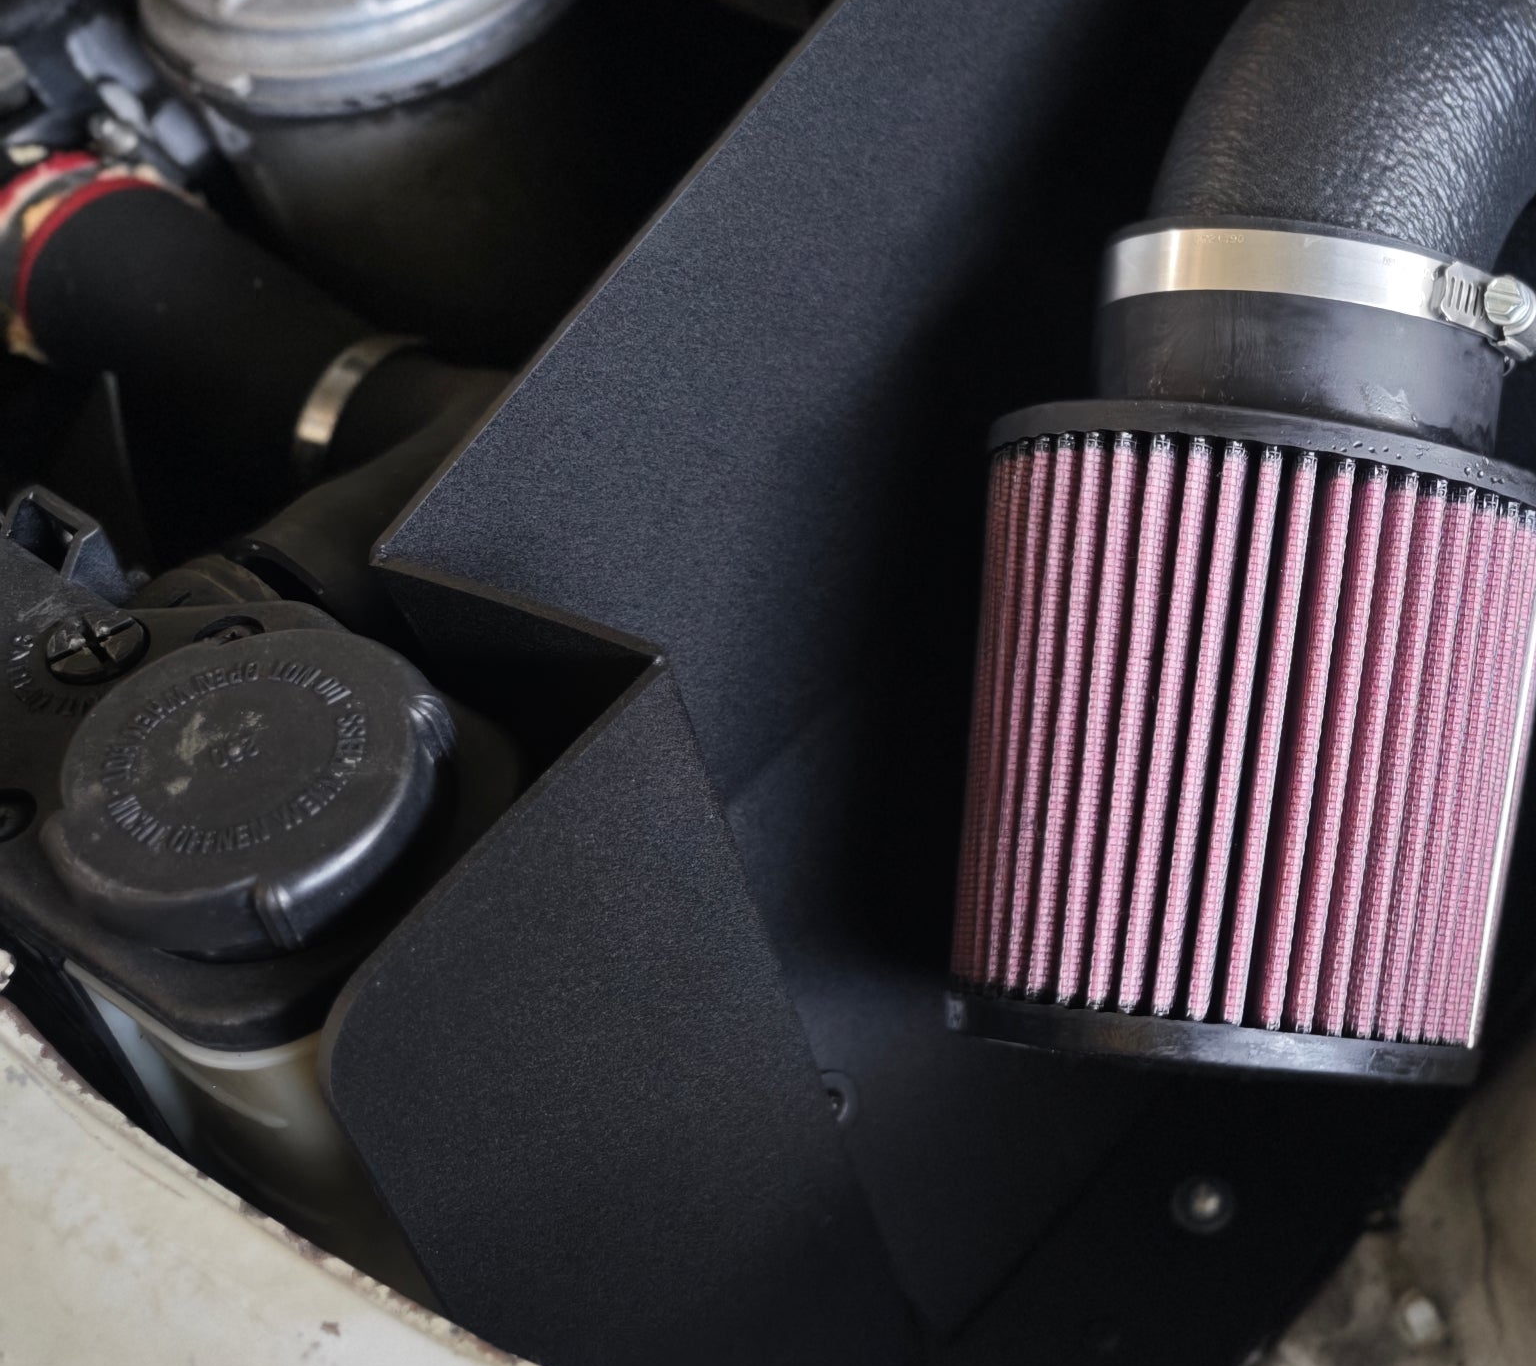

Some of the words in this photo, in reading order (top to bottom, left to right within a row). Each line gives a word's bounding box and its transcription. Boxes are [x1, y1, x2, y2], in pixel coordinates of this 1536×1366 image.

[195, 660, 260, 695] OPEN
[267, 660, 324, 689] NOT
[314, 675, 353, 706] DO
[107, 792, 171, 853] NICHT
